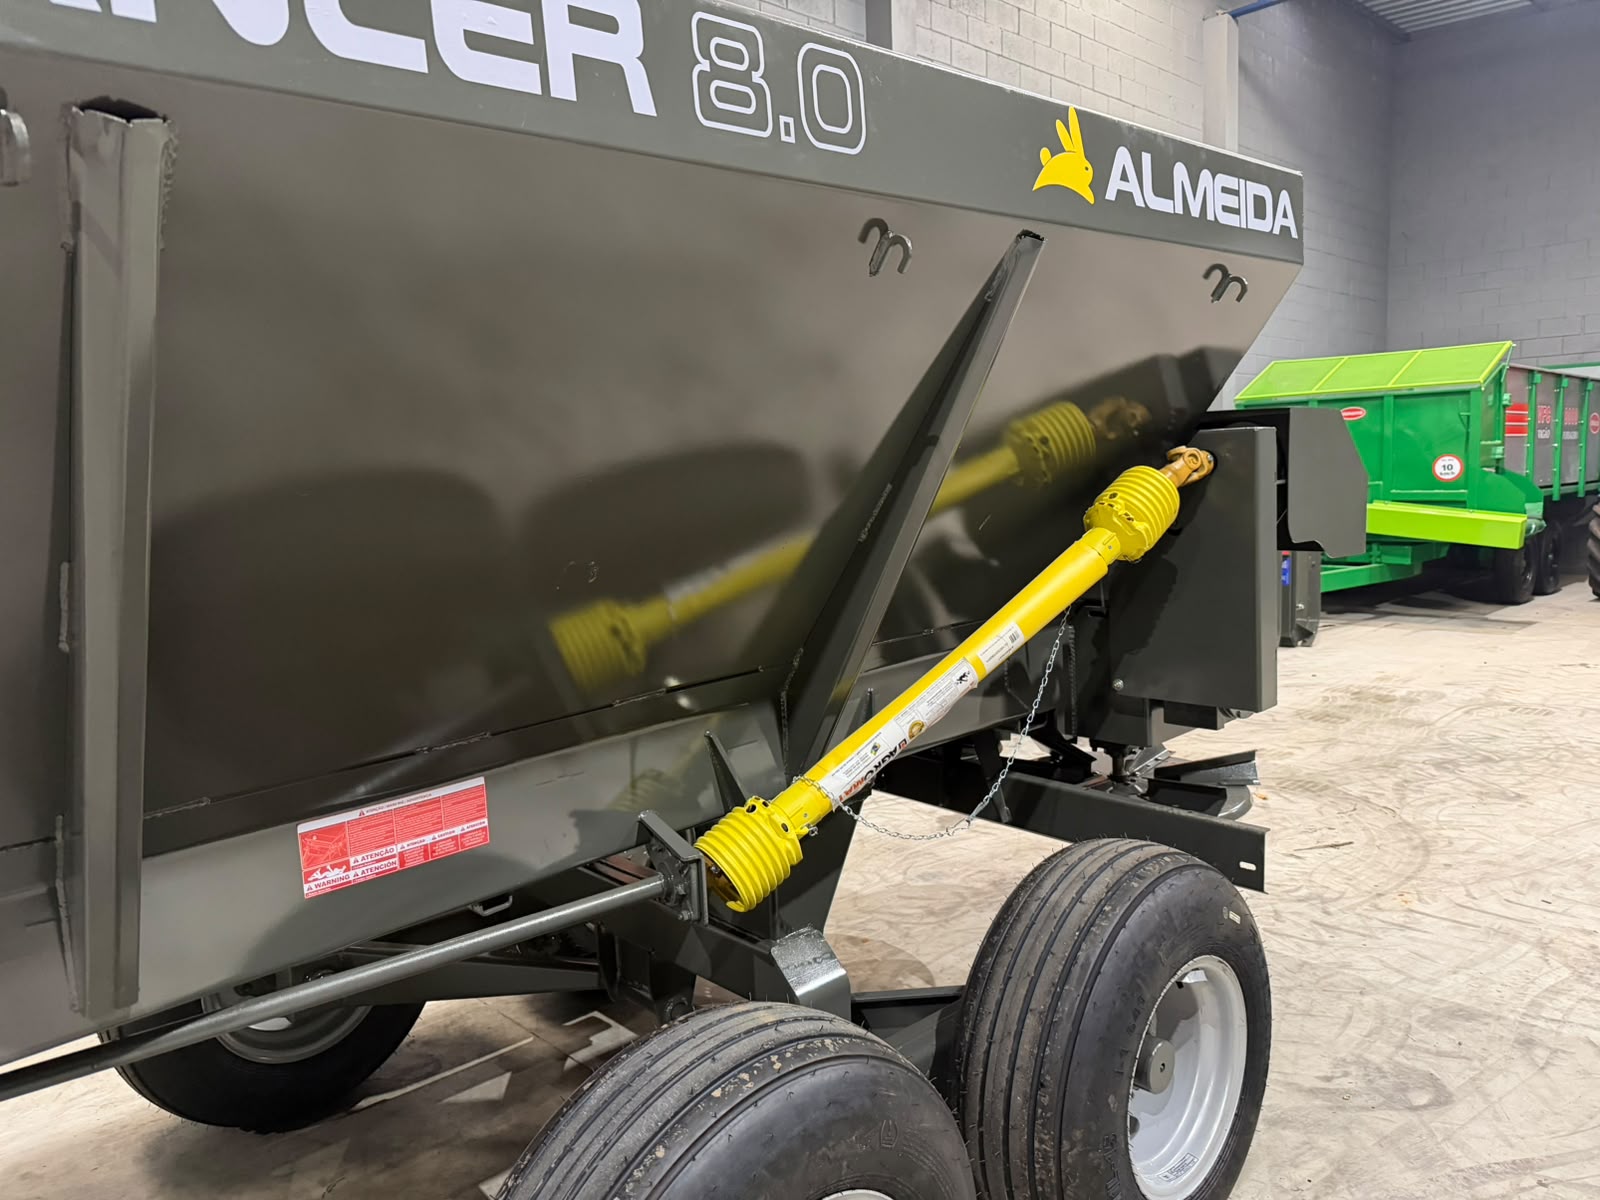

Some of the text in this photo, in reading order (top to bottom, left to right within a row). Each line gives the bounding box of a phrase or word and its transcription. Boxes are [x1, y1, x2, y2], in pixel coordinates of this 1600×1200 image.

[691, 11, 867, 155] 8.0
[1105, 146, 1299, 240] ALMEIDA
[1441, 463, 1453, 471] 10
[360, 847, 395, 862] ATENÇÃO
[360, 859, 397, 875] ATENCIÓN
[314, 874, 350, 889] WARNING
